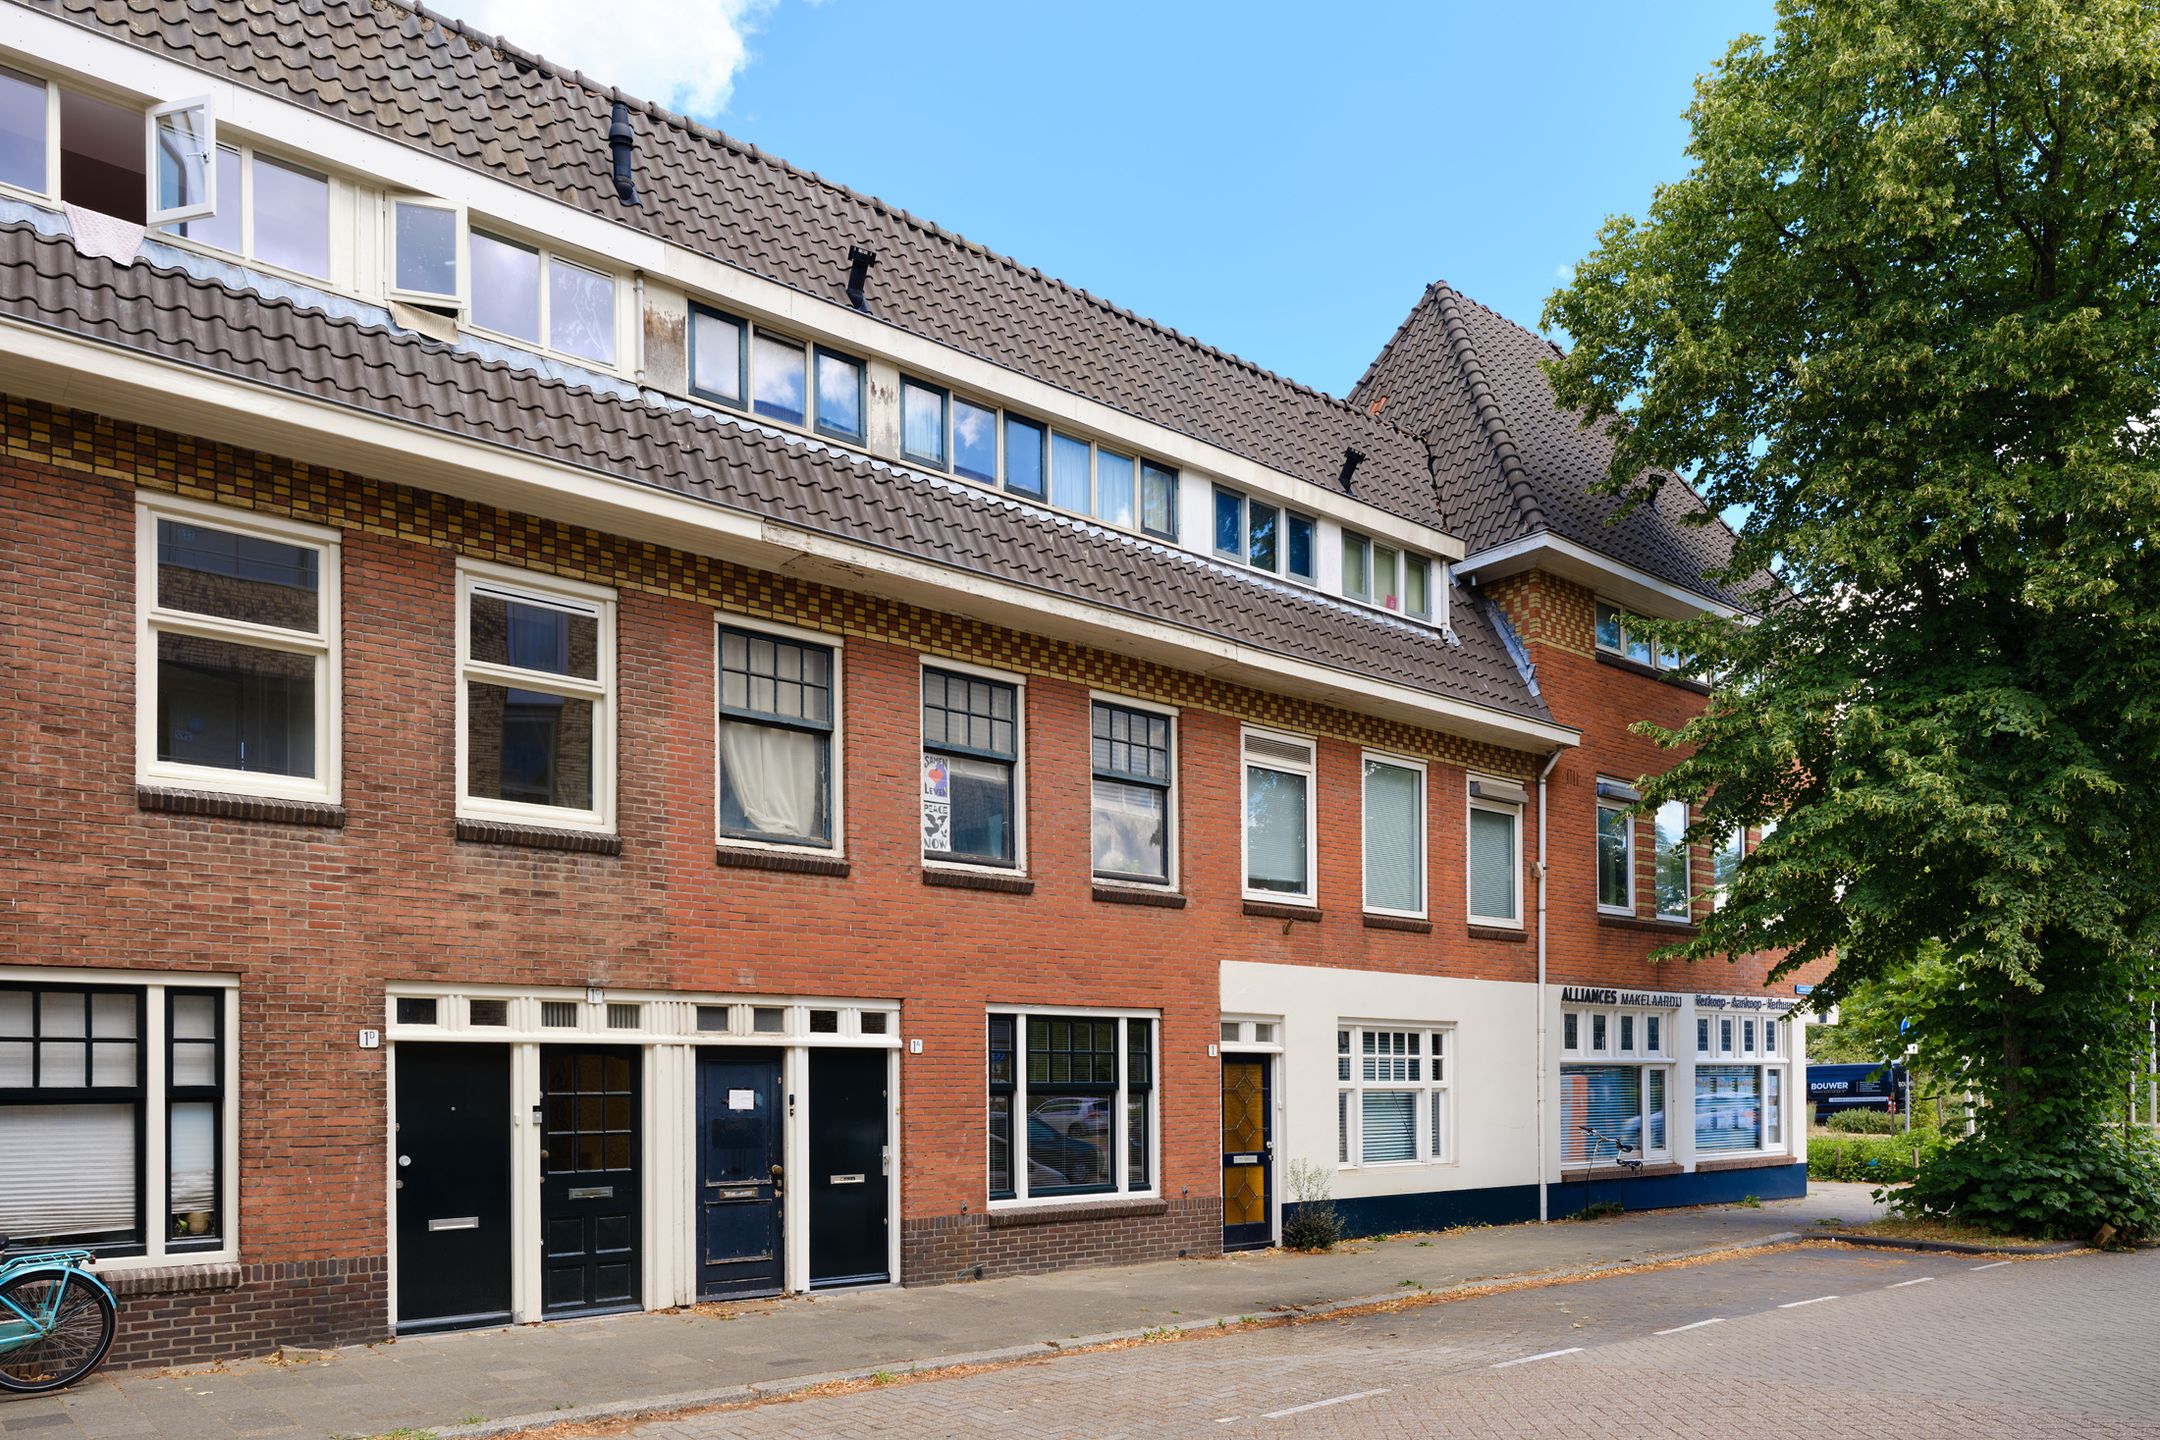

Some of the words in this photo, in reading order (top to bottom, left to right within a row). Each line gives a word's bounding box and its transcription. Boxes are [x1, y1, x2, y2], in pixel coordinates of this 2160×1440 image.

[924, 804, 948, 815] PEACE
[924, 838, 948, 850] NOW
[1561, 987, 1617, 1005] ALLIANCES
[1620, 993, 1682, 1008] MAKELAARDIJ
[1811, 1081, 1849, 1090] BOUWER
